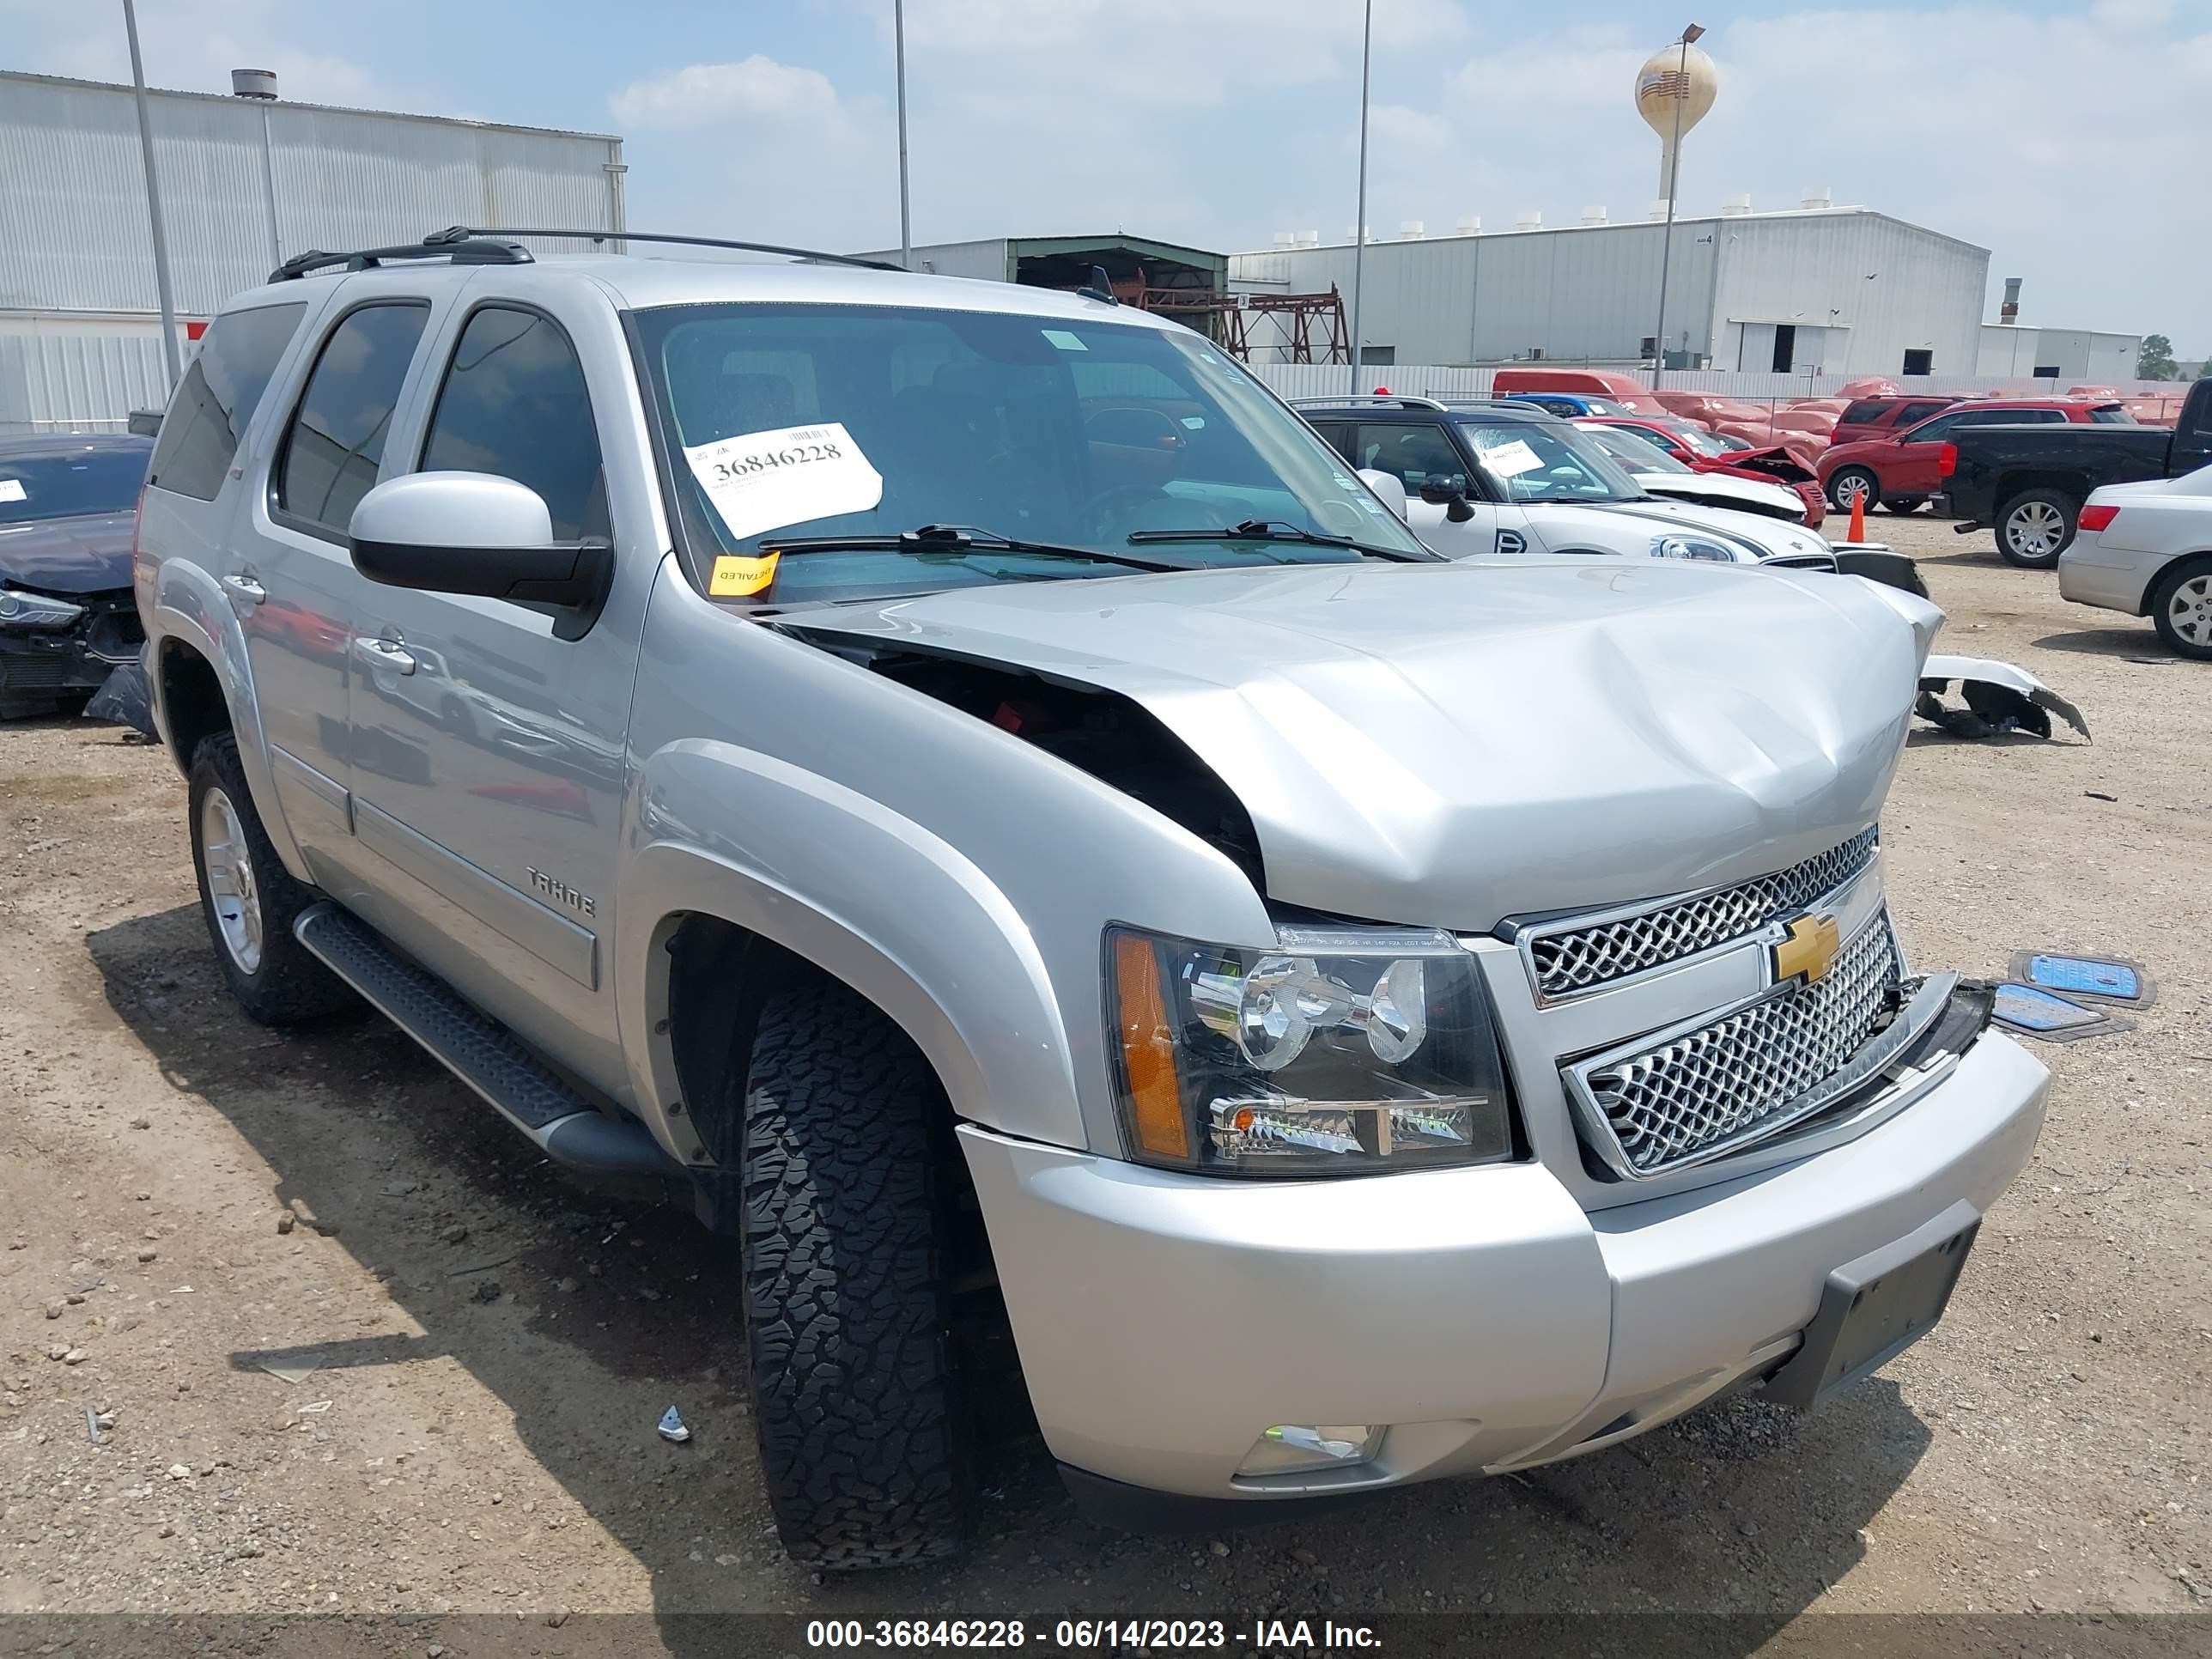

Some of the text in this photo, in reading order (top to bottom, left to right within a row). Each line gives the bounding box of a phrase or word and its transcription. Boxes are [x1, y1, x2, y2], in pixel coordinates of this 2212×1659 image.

[713, 443, 842, 481] 36846228
[720, 567, 771, 581] DETAILED
[526, 866, 595, 918] TAHOE
